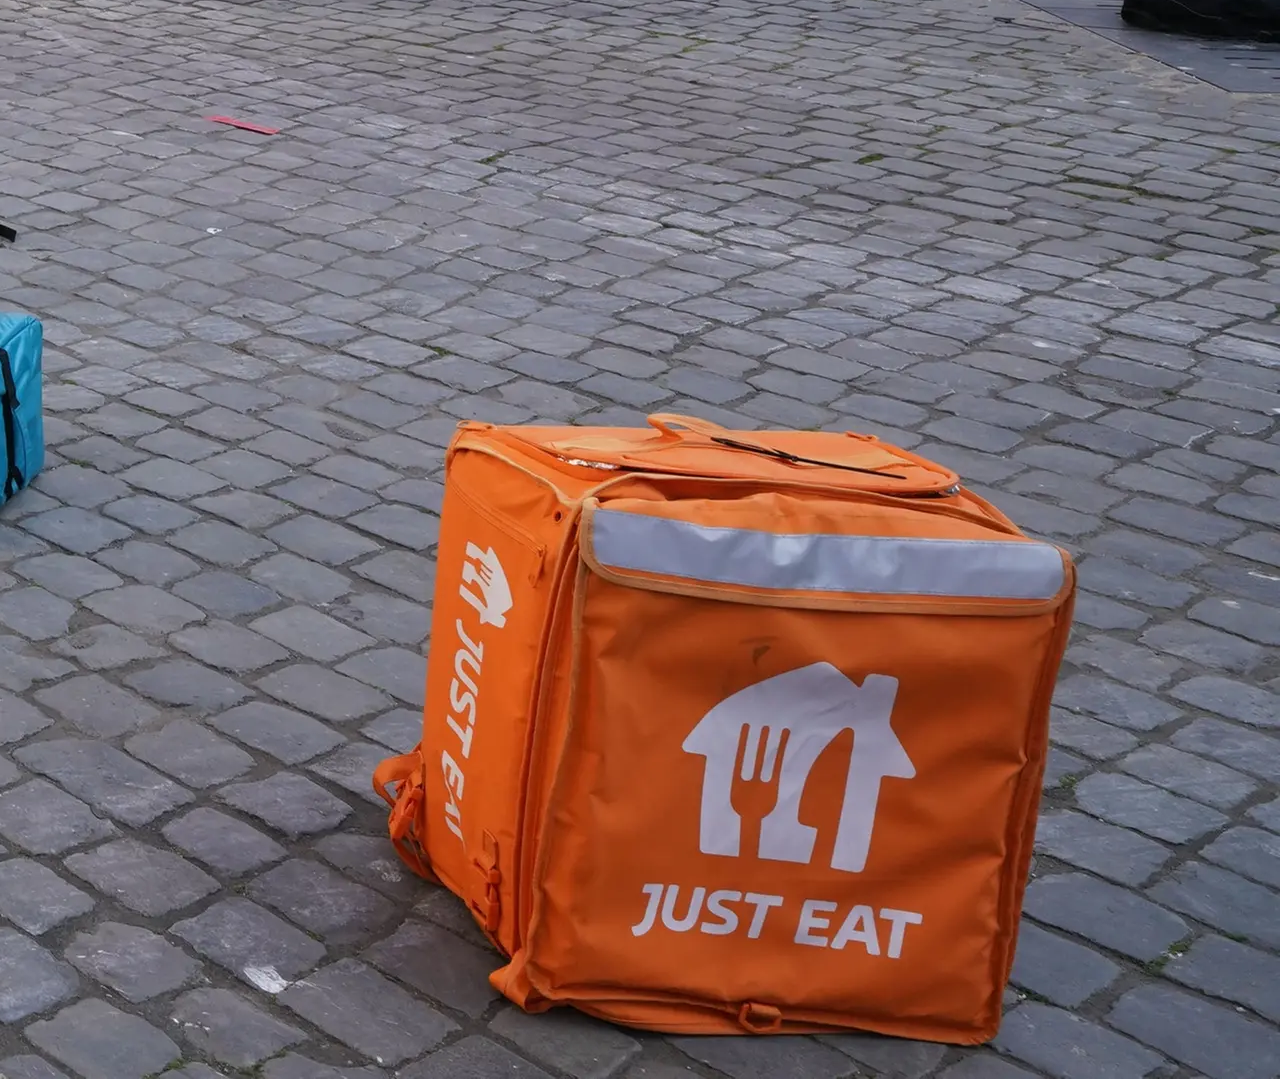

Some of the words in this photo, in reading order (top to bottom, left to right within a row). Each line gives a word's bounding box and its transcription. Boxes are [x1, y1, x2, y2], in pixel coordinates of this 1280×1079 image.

[447, 619, 484, 759] JUST
[631, 883, 784, 939] JUST
[794, 898, 923, 959] EAT
